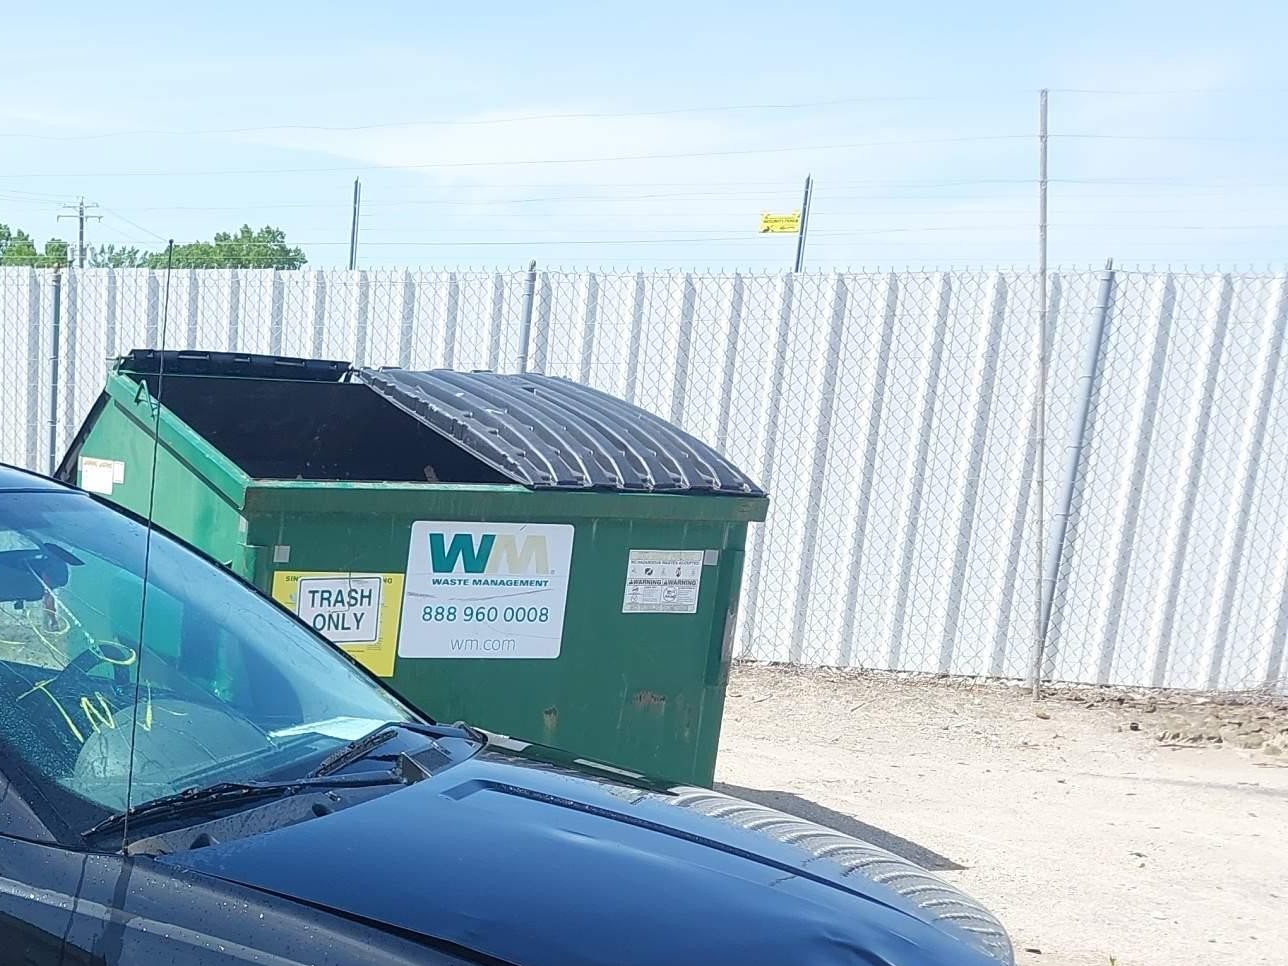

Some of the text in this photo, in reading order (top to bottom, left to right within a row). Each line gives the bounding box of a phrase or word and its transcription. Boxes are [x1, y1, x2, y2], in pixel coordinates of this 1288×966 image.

[429, 532, 550, 575] WM
[432, 578, 550, 587] WASTE MANAGEMENT
[308, 588, 373, 609] TRASH
[312, 612, 365, 632] ONLY
[422, 606, 550, 623] 888 960 0008
[450, 638, 516, 651] wm.com
